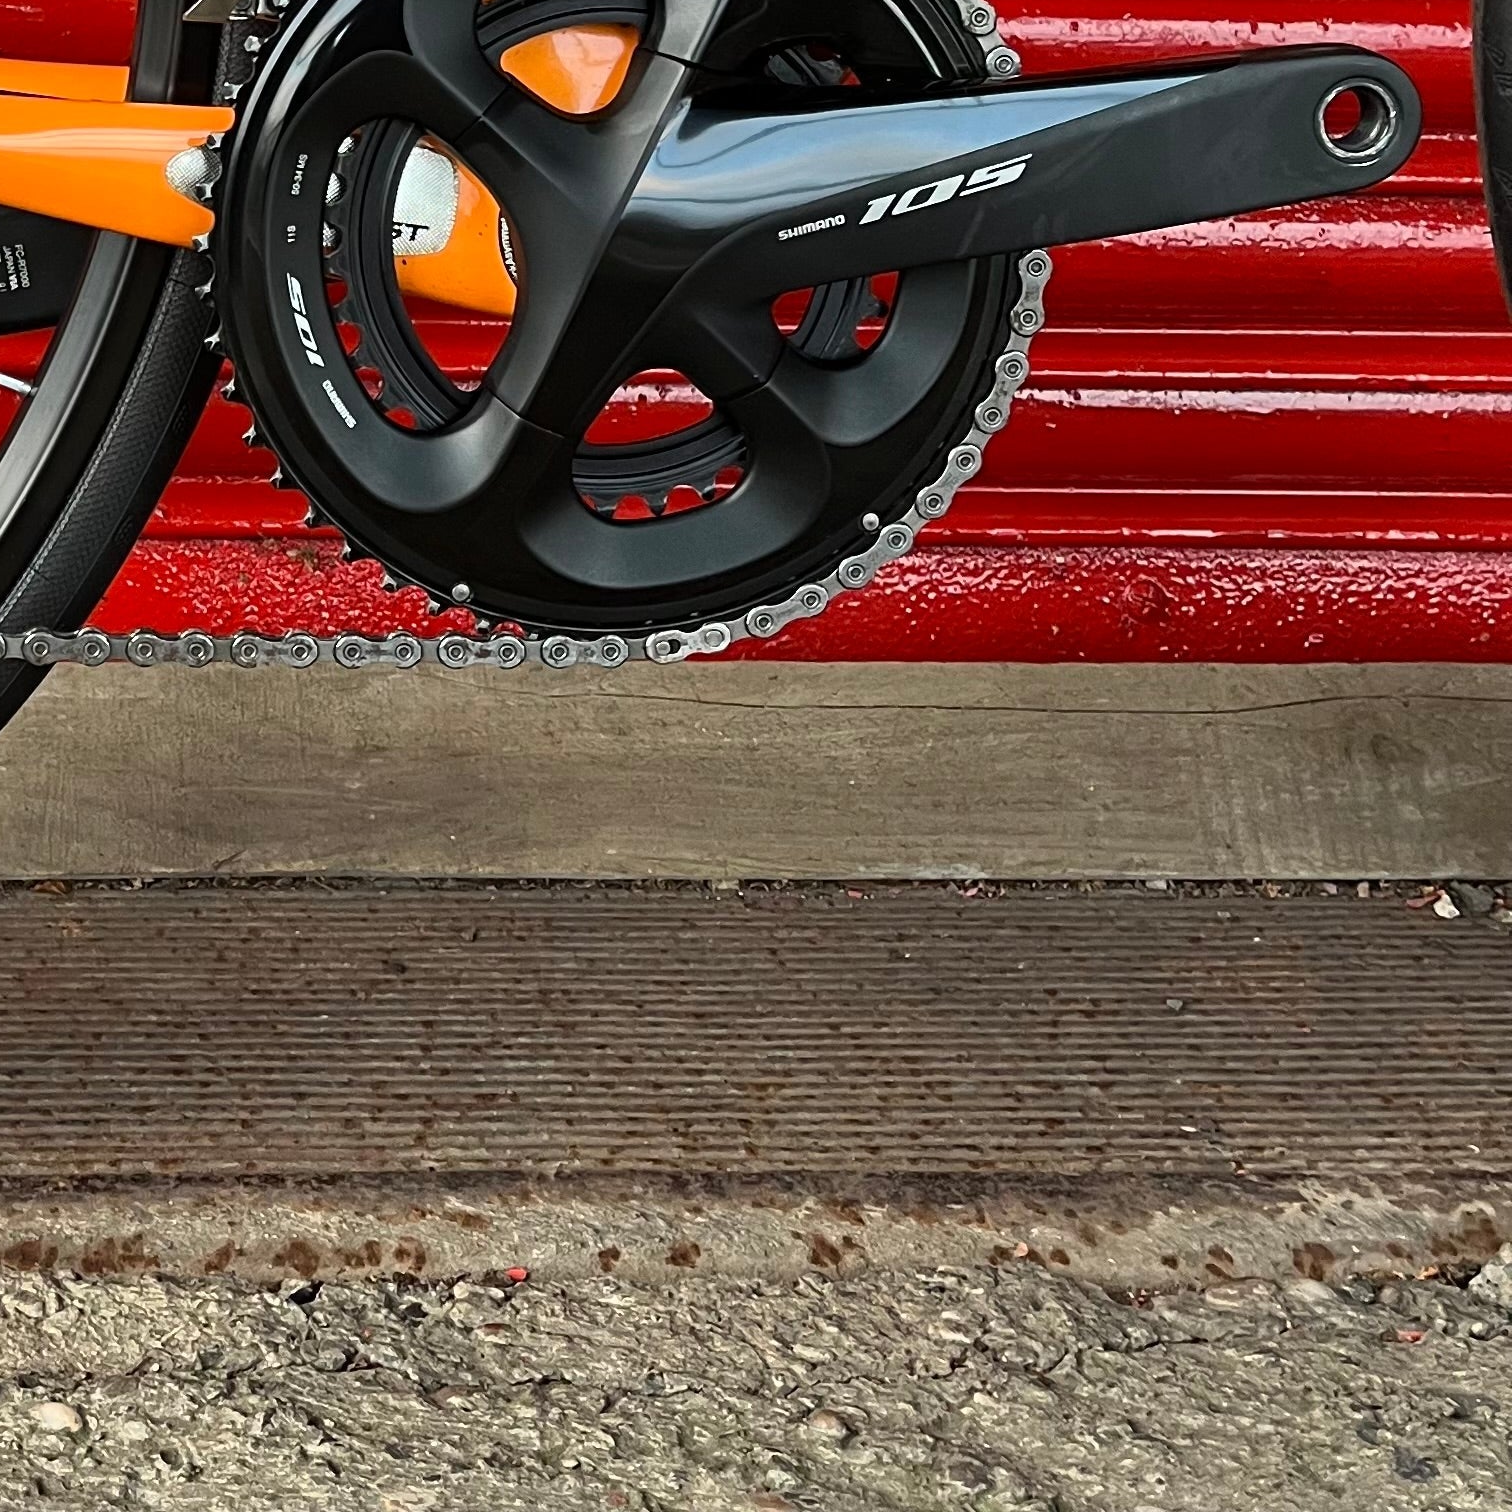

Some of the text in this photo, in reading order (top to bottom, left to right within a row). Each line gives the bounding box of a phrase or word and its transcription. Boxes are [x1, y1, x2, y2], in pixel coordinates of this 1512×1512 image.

[777, 153, 1033, 241] SHIMANO 105
[286, 272, 326, 368] 105
